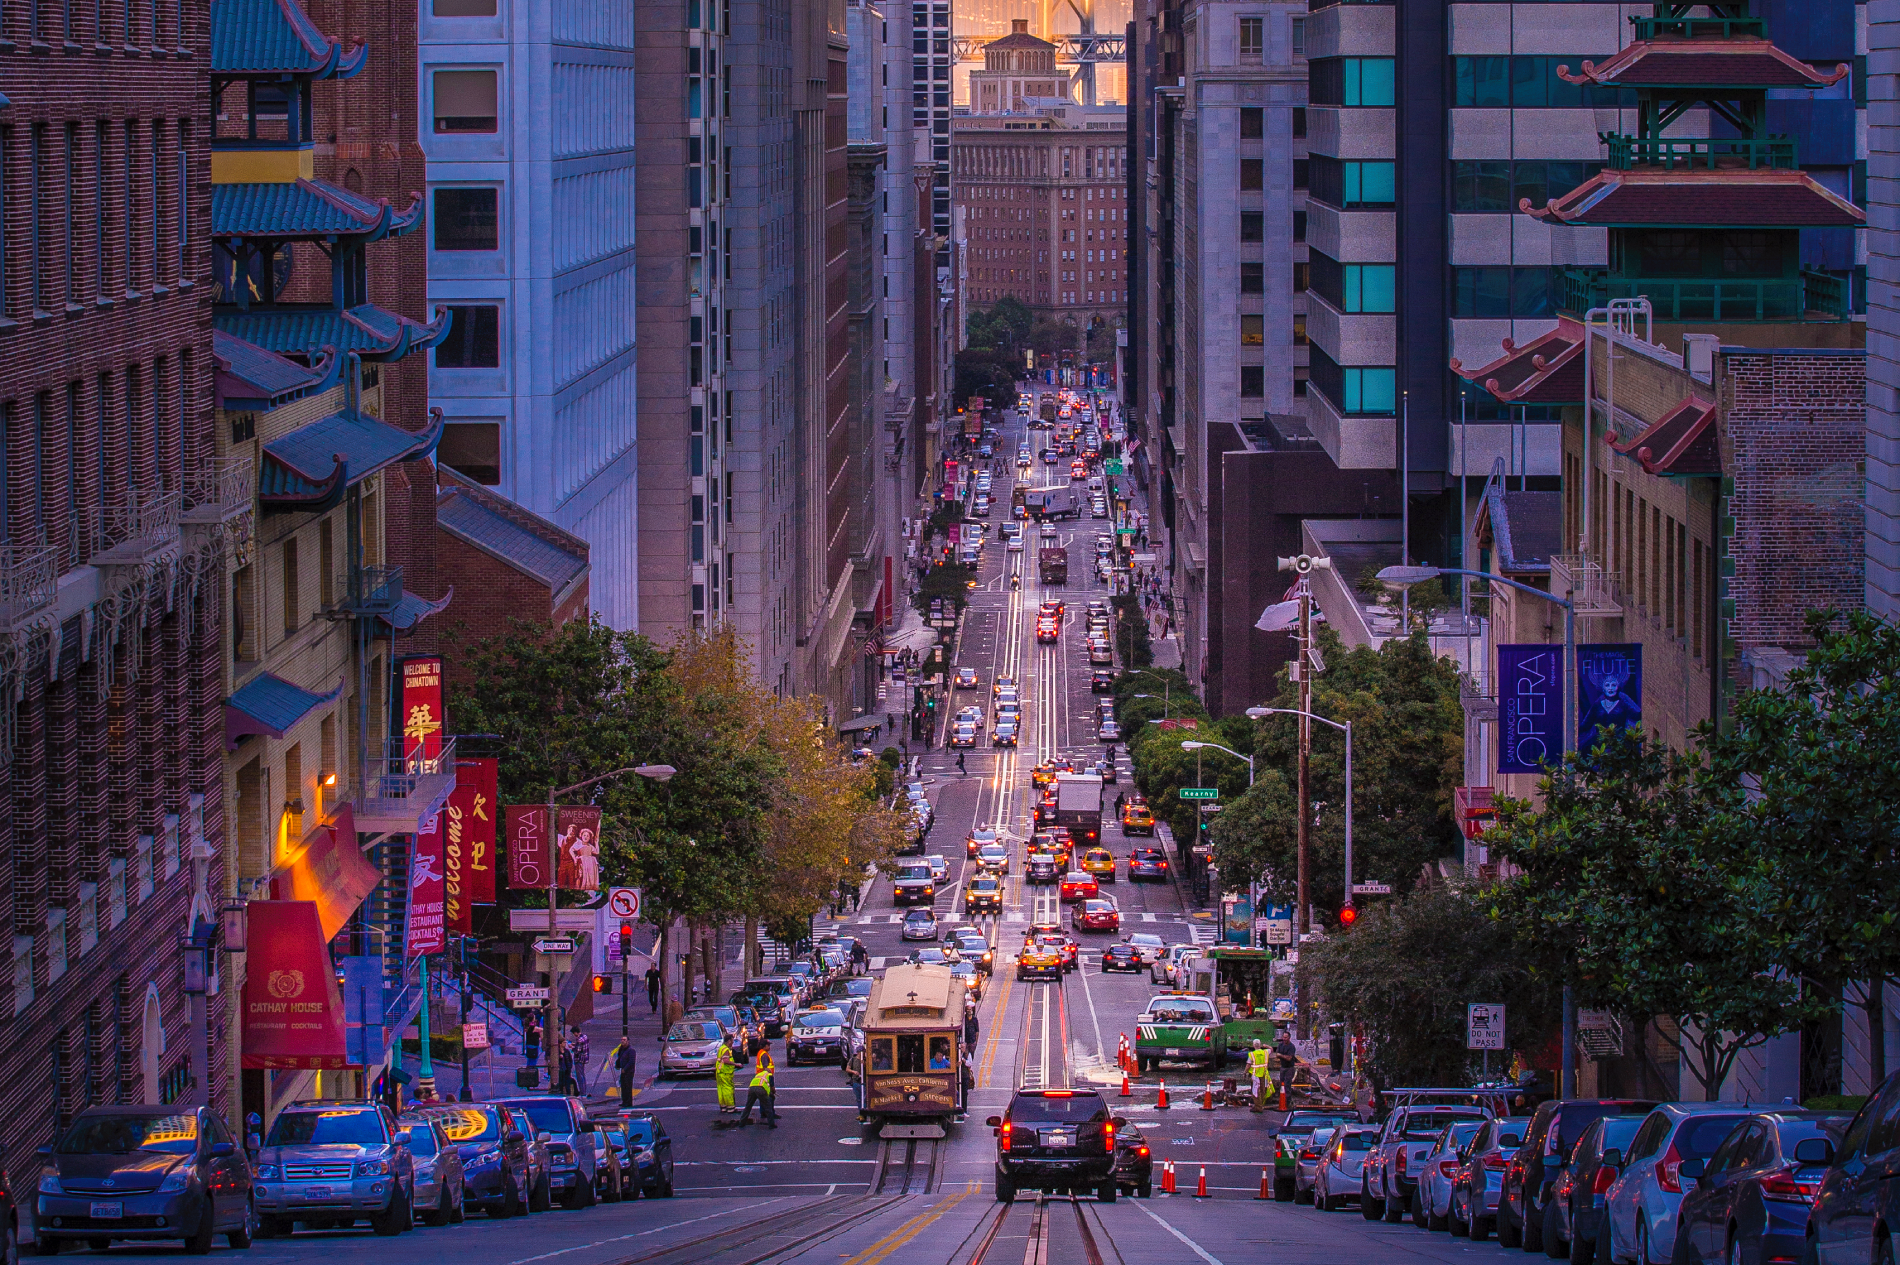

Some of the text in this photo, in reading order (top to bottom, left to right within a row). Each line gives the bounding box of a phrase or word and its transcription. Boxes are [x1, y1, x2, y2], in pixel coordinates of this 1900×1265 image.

[404, 663, 440, 676] WELCOME TO
[1582, 658, 1636, 675] FLUTE
[405, 676, 438, 688] CHINATOWN
[1516, 653, 1546, 766] OPERA
[1506, 698, 1516, 763] SAN FRANCISCO
[560, 810, 599, 818] SWEENEY
[518, 810, 540, 884] OPERA
[411, 902, 443, 914] ATHAY HOUSE
[410, 914, 443, 928] ESTAURANT
[250, 1003, 322, 1012] CATHAY HOUSE
[880, 1094, 901, 1103] Market
[924, 1094, 949, 1102] Streets
